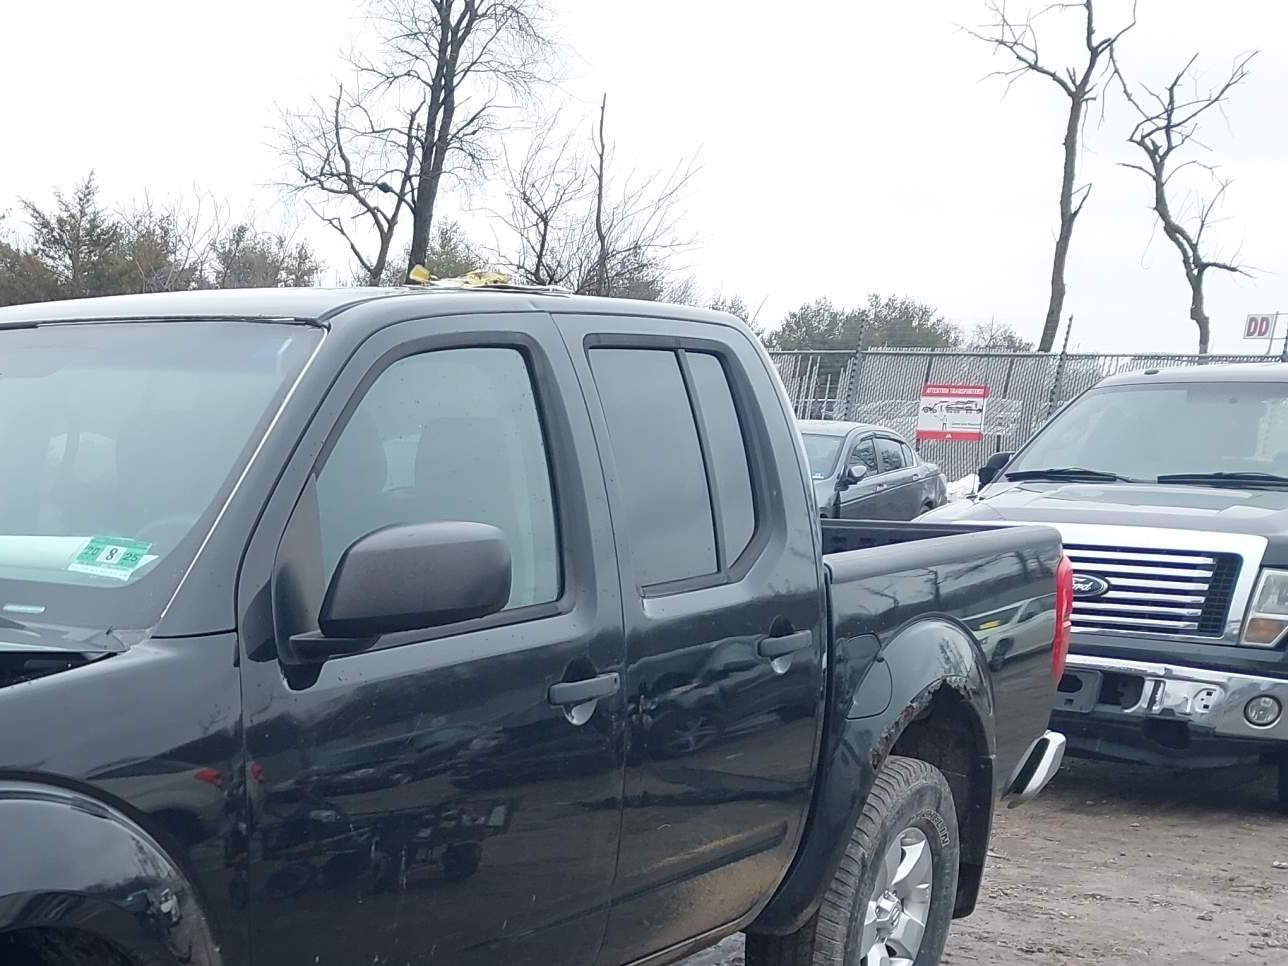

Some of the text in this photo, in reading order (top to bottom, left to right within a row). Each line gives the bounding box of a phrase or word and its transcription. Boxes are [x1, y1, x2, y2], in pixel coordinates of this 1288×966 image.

[1246, 316, 1270, 337] DD
[105, 547, 118, 561] 8
[121, 551, 138, 562] 25
